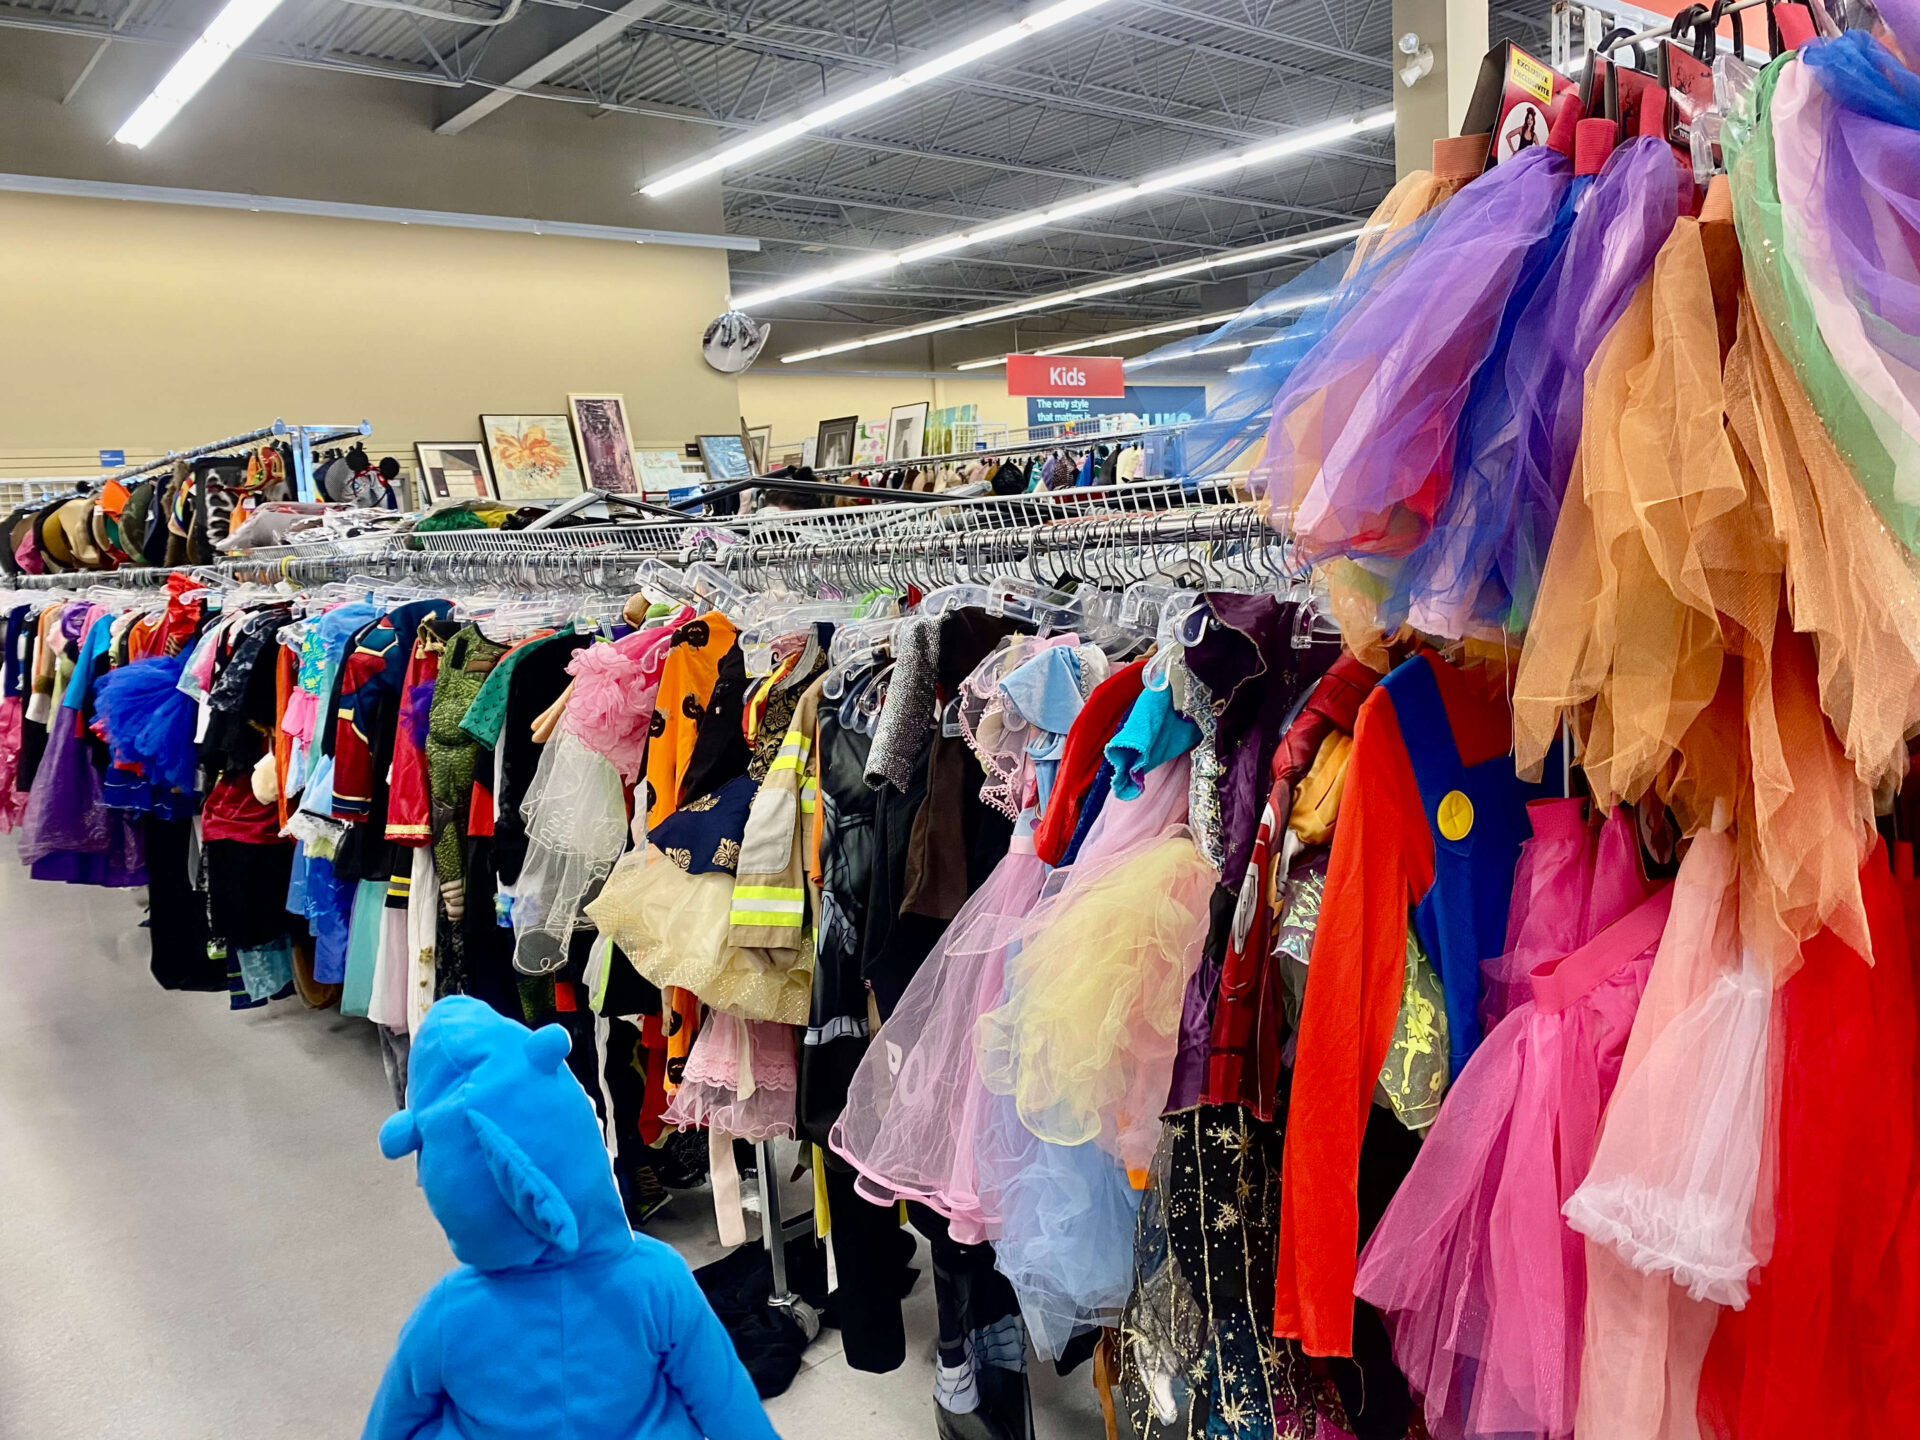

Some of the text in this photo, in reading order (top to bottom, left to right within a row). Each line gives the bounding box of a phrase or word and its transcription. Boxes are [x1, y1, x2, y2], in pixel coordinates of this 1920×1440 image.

[1516, 58, 1548, 84] EXCLUSIVE
[1050, 366, 1087, 386] Kids
[1036, 398, 1089, 410] The only style
[1037, 412, 1054, 422] that
[1054, 412, 1084, 422] matters
